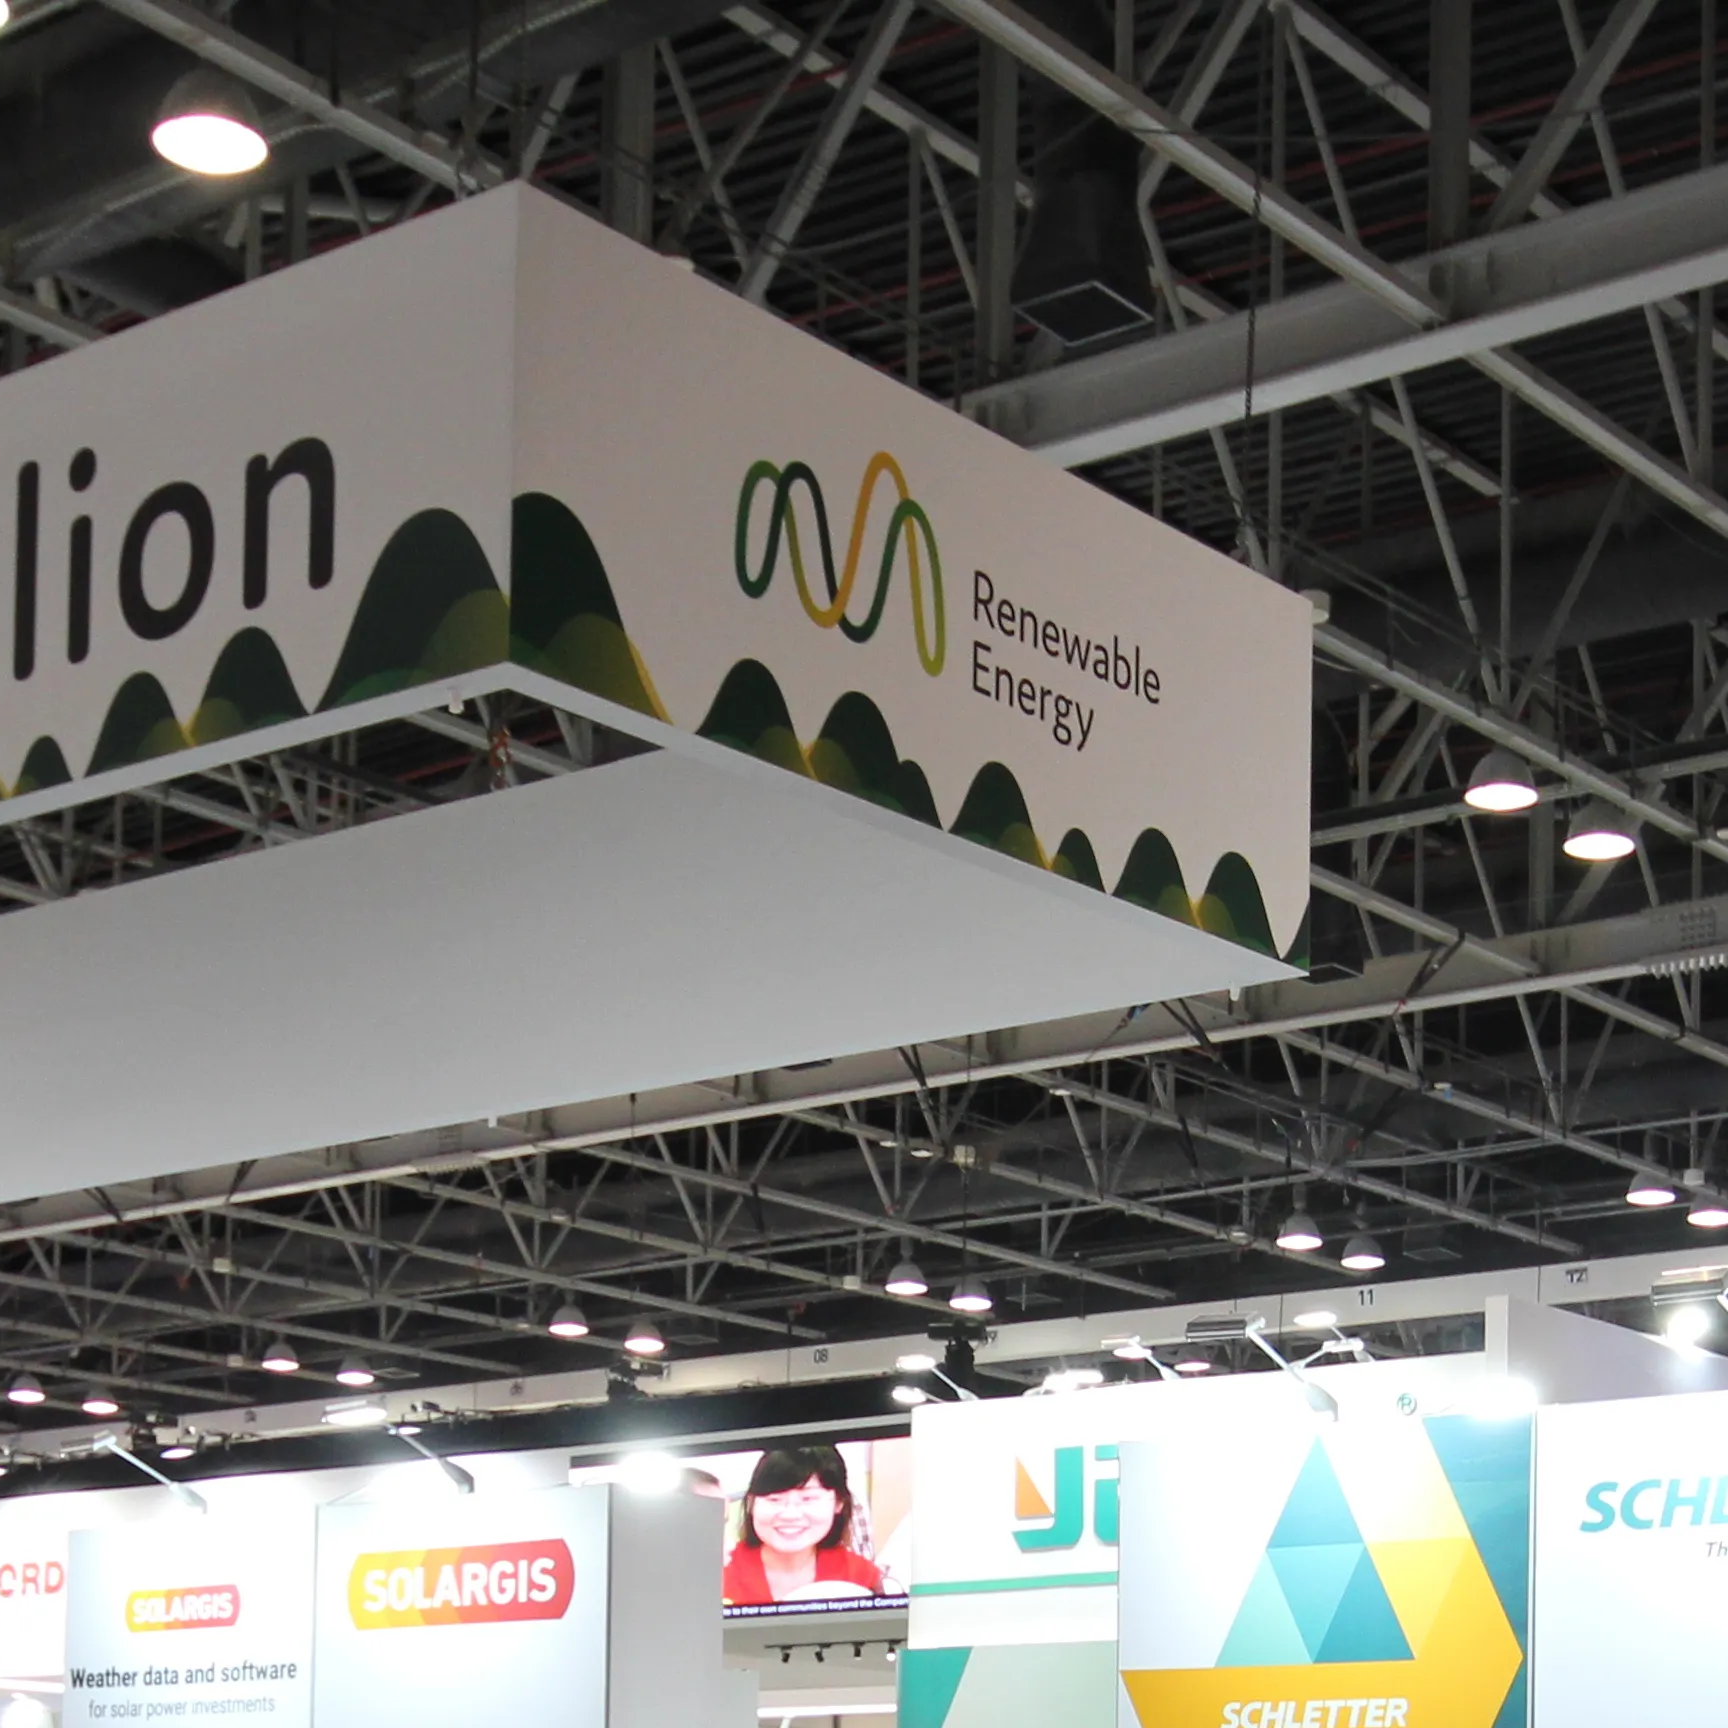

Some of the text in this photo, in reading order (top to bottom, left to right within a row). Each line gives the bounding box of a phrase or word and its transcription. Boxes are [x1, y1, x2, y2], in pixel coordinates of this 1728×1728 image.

[972, 569, 1161, 705] Renewable
[972, 641, 1094, 751] Energy
[1358, 1289, 1374, 1306] 11
[813, 1349, 829, 1364] 08
[363, 1557, 557, 1613] SOLARGIS
[132, 1591, 235, 1625] SOLARGIS
[778, 1602, 827, 1614] communities
[829, 1600, 859, 1611] beyond
[71, 1660, 297, 1689] Weather data and software
[88, 1697, 276, 1721] for solar power investments
